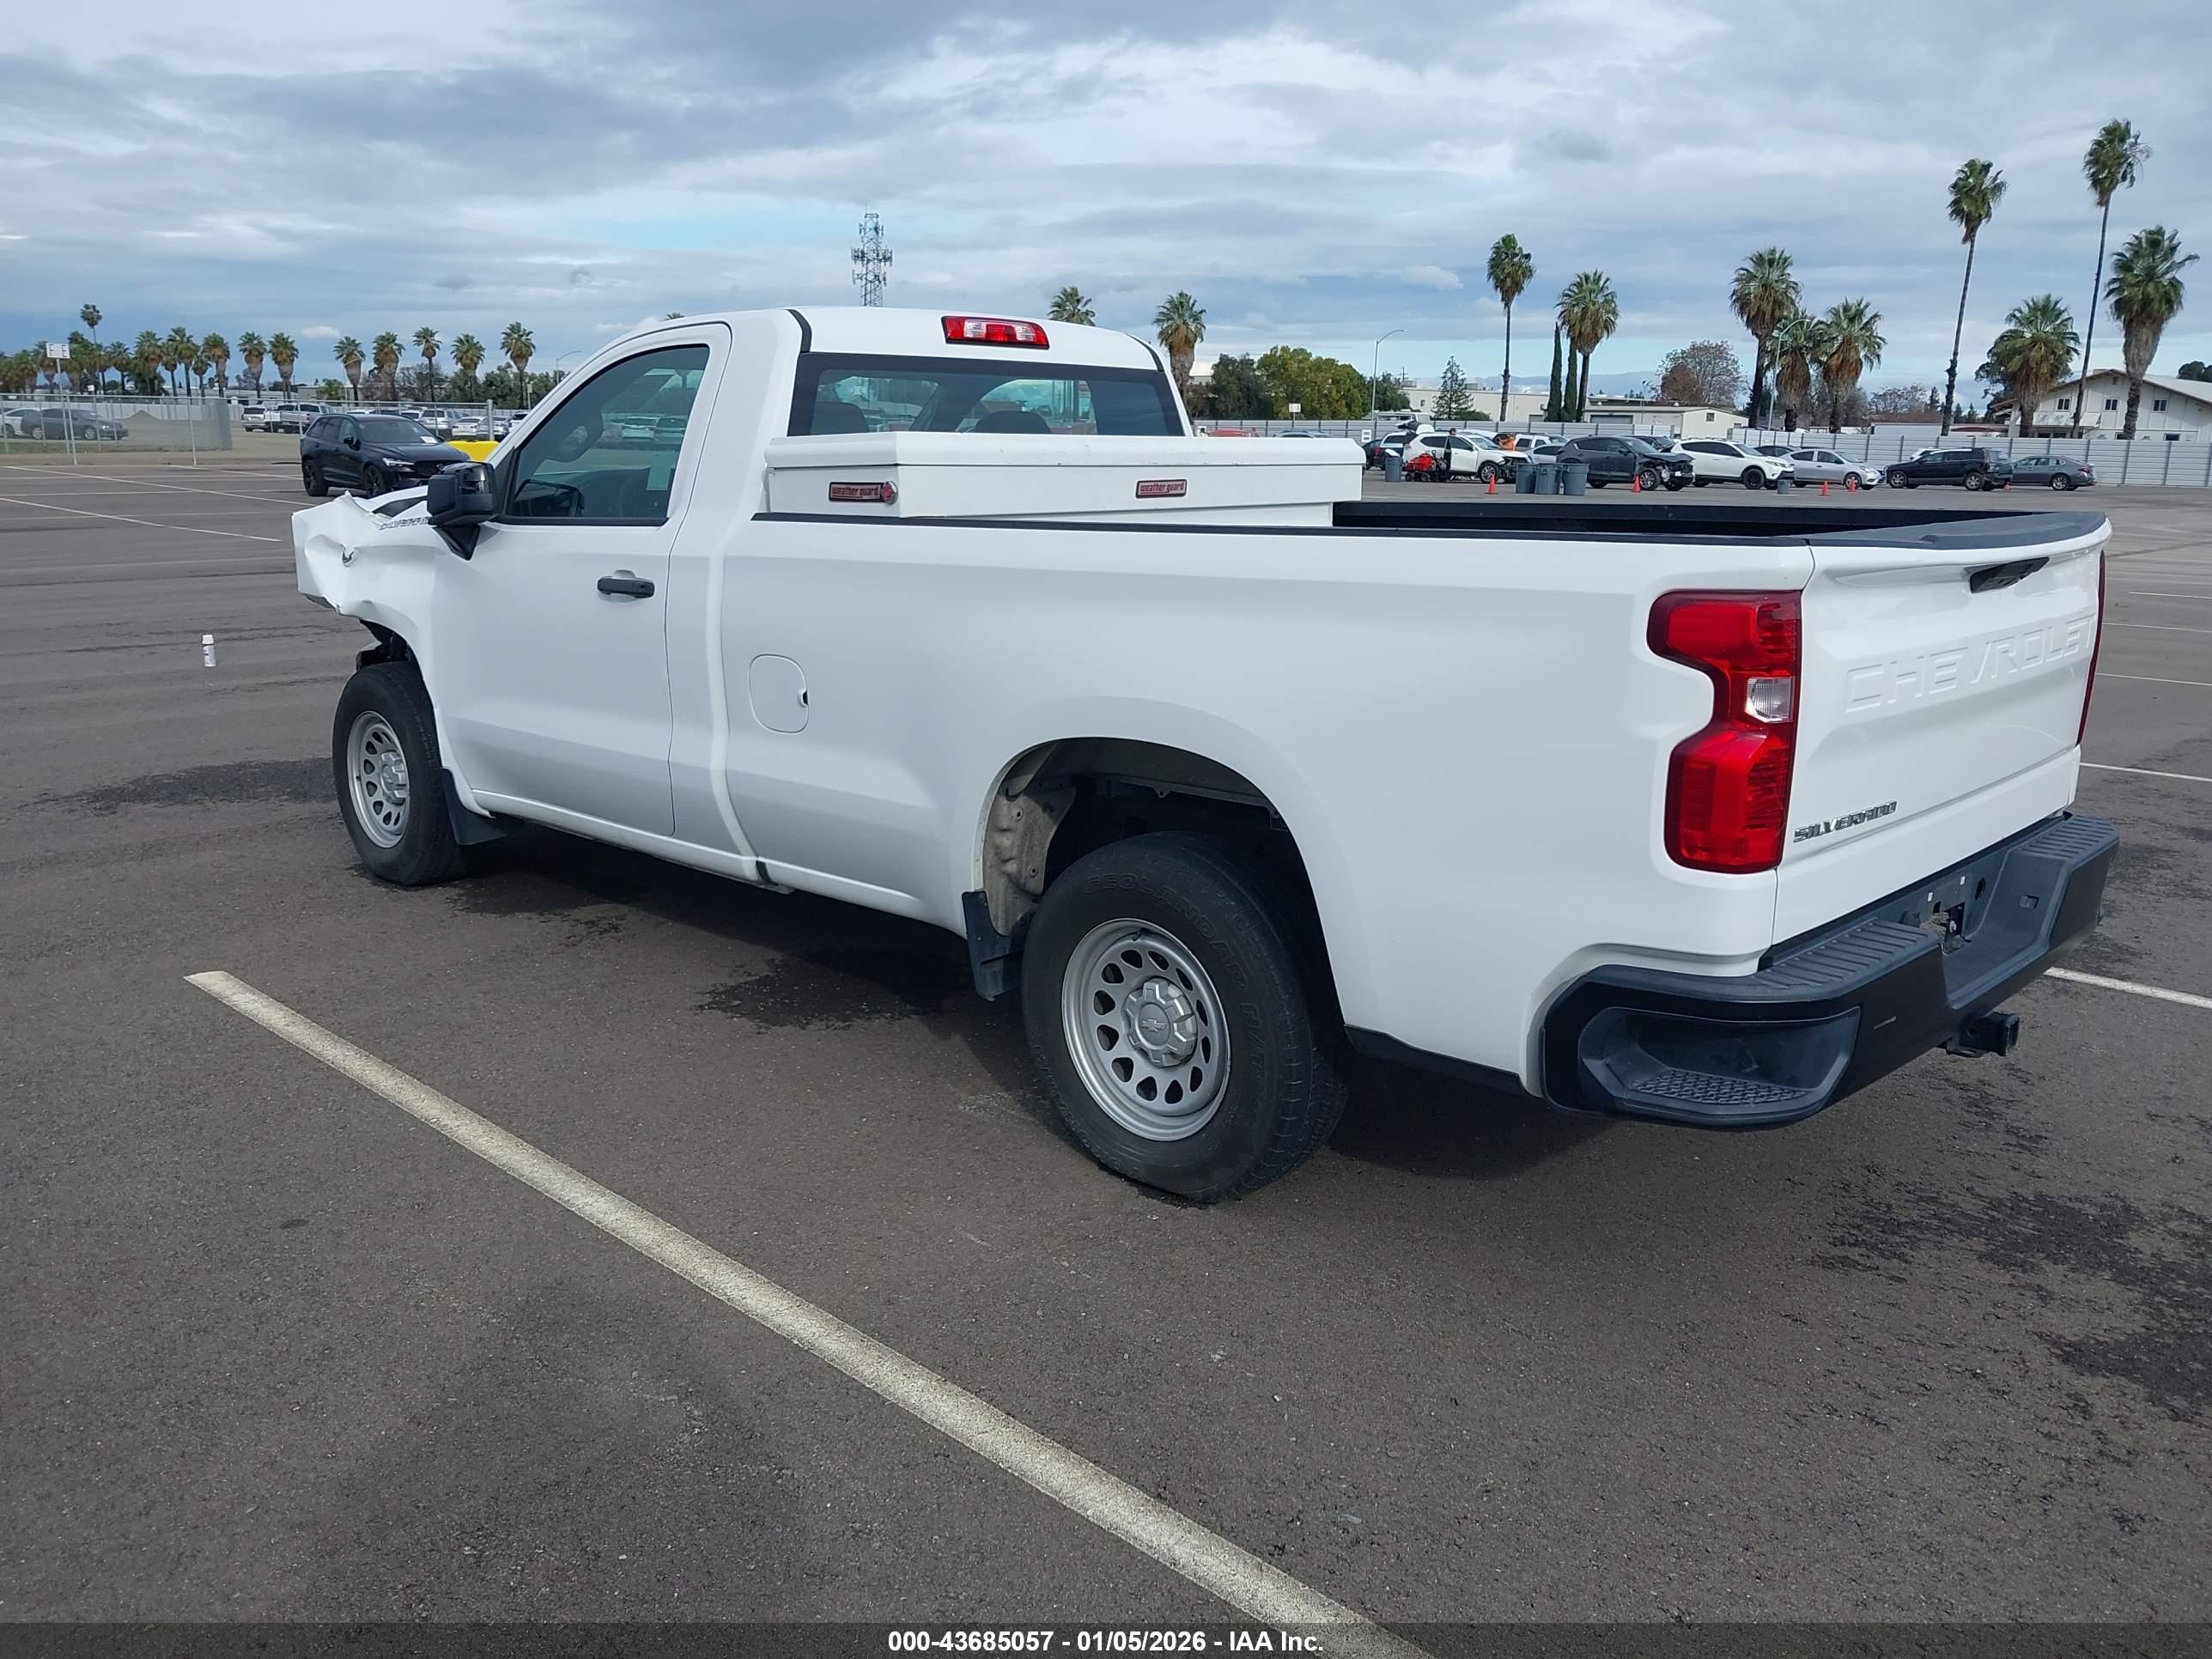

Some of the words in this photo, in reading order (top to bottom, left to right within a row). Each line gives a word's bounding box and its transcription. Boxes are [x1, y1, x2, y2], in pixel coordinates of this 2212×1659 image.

[1139, 483, 1165, 492] weather
[1167, 483, 1184, 494] guard
[1845, 613, 2096, 713] CHEVROLET
[1792, 800, 1898, 843] SILVERADO
